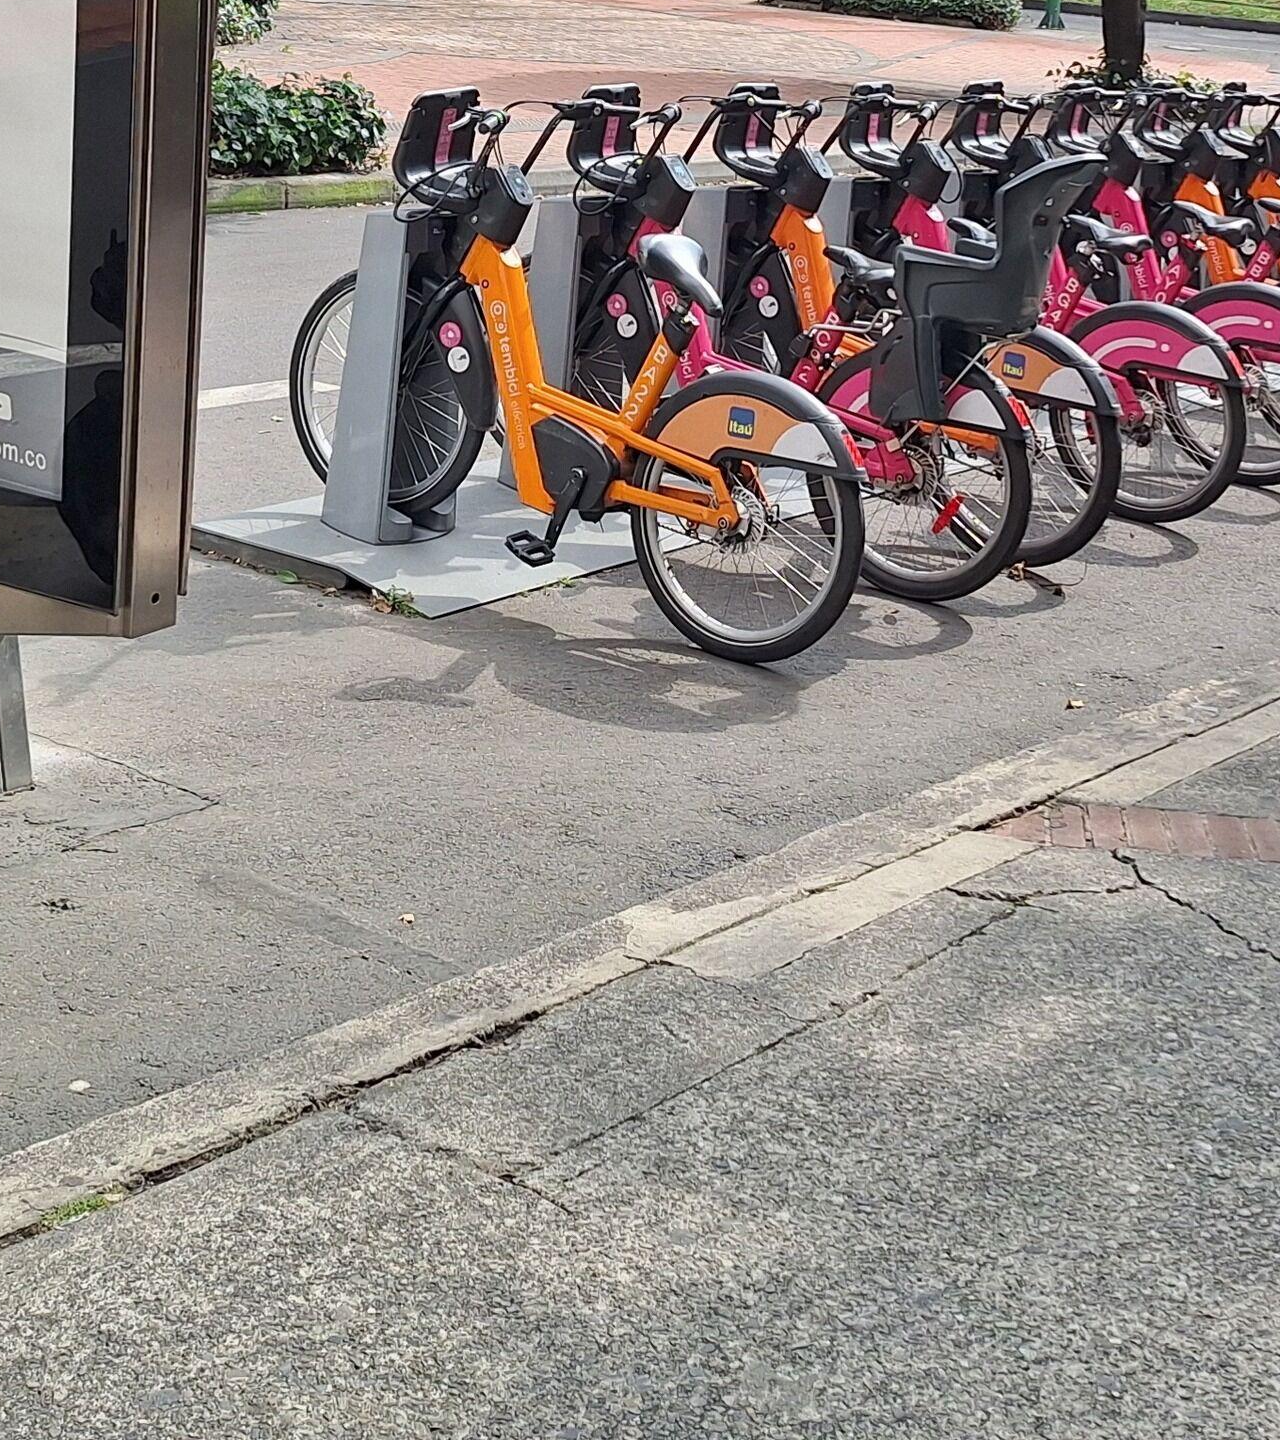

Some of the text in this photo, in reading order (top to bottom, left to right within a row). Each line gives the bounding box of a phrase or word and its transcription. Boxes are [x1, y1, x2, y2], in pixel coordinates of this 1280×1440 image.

[499, 335, 518, 400] tembici
[624, 345, 669, 422] BA22
[729, 420, 753, 436] Itaú
